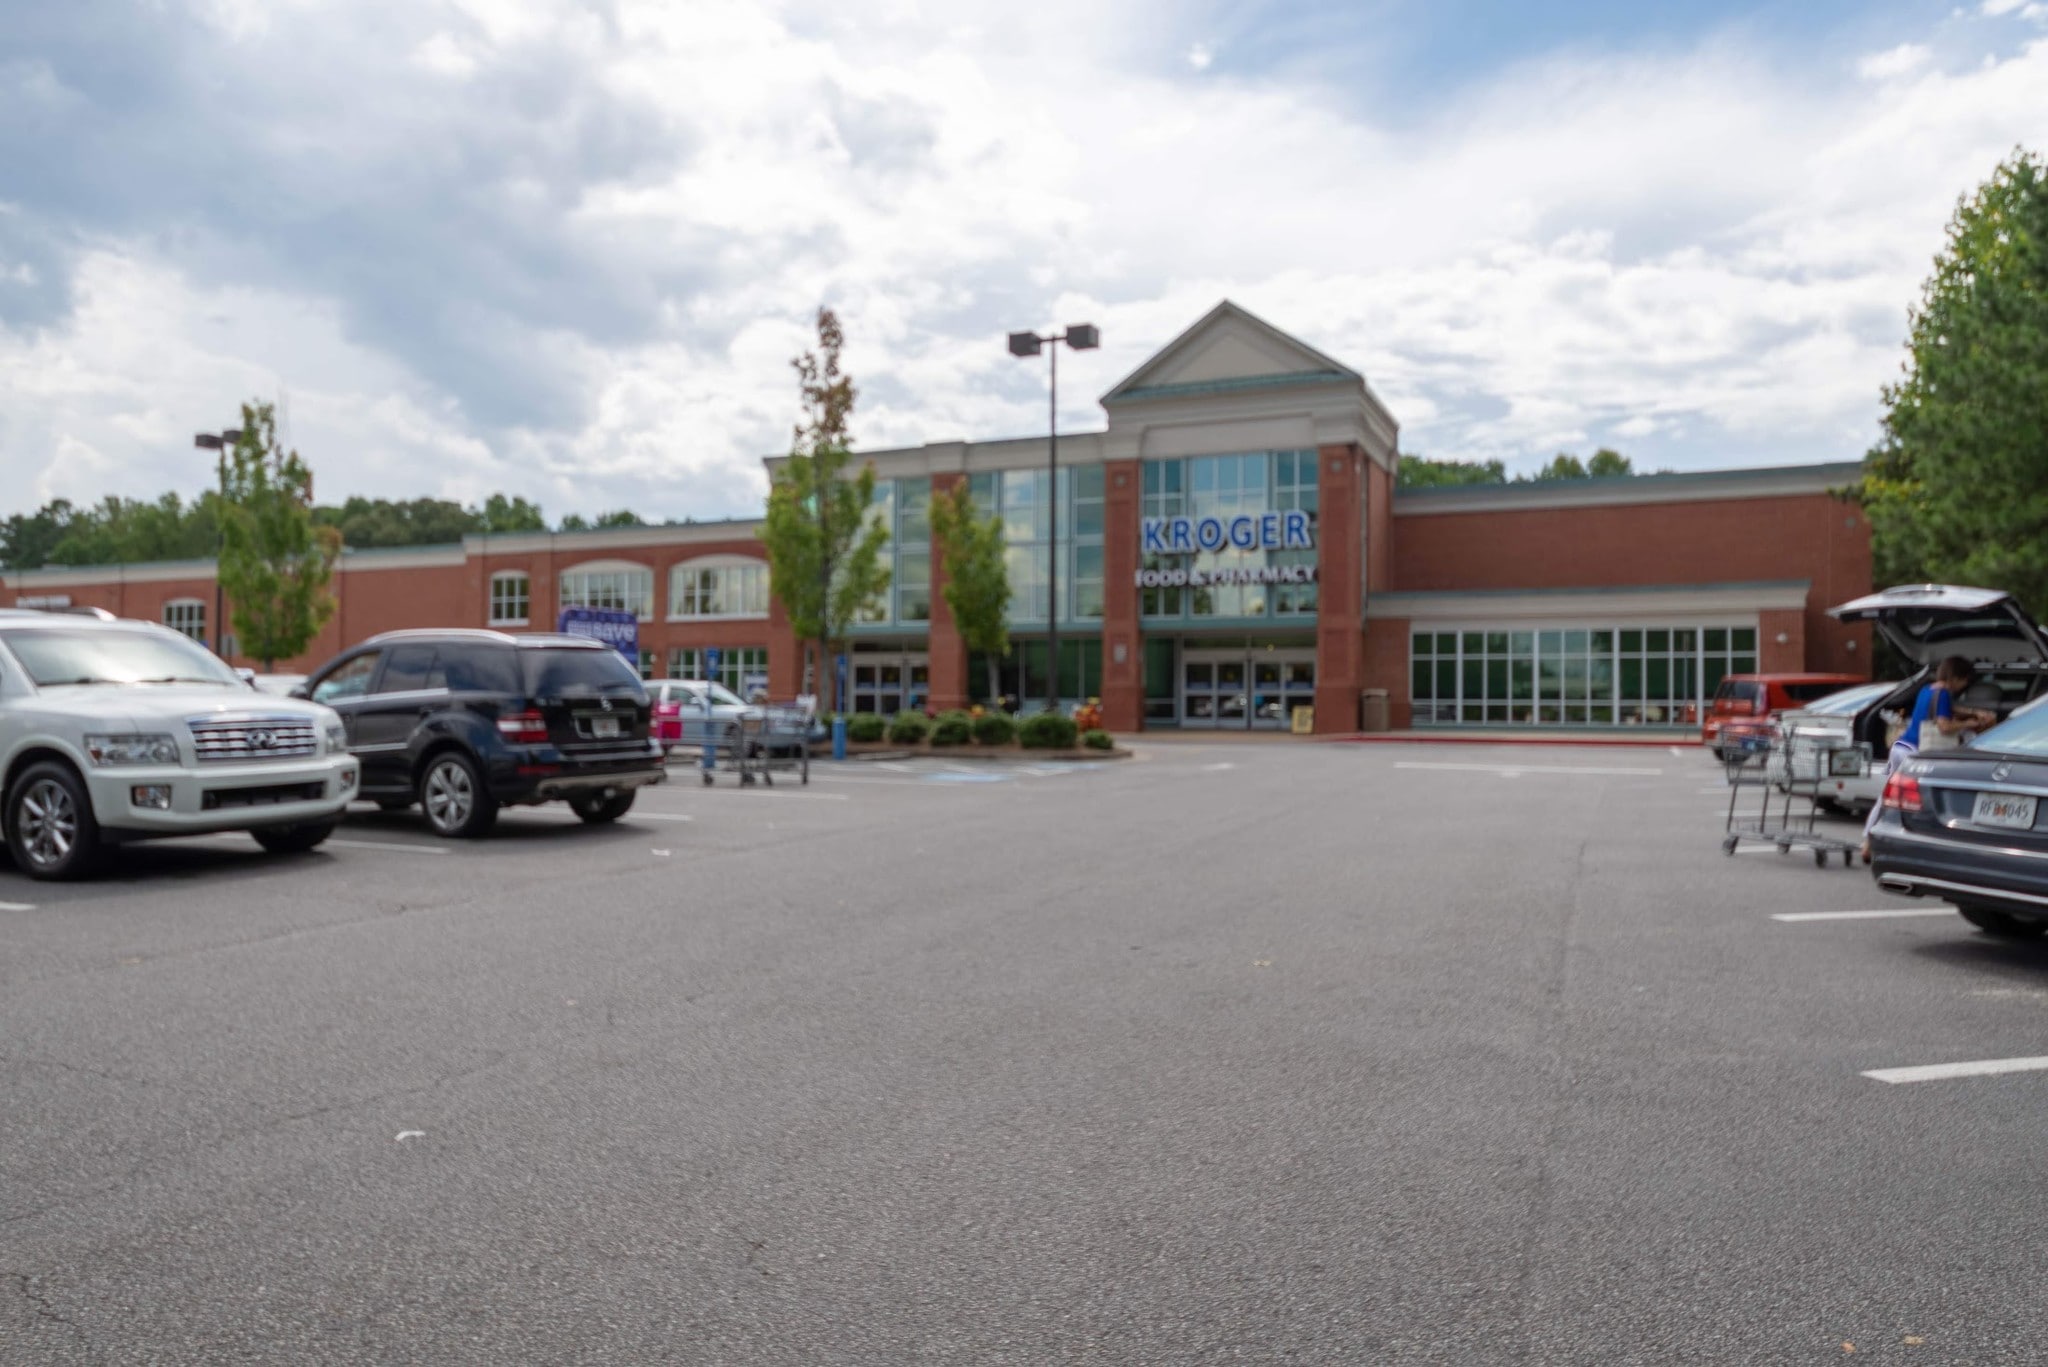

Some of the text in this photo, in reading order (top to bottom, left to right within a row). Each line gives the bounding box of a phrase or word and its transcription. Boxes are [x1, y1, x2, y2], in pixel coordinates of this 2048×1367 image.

[1142, 511, 1311, 553] KROGER
[1135, 564, 1315, 588] FOOD & PHARMACY
